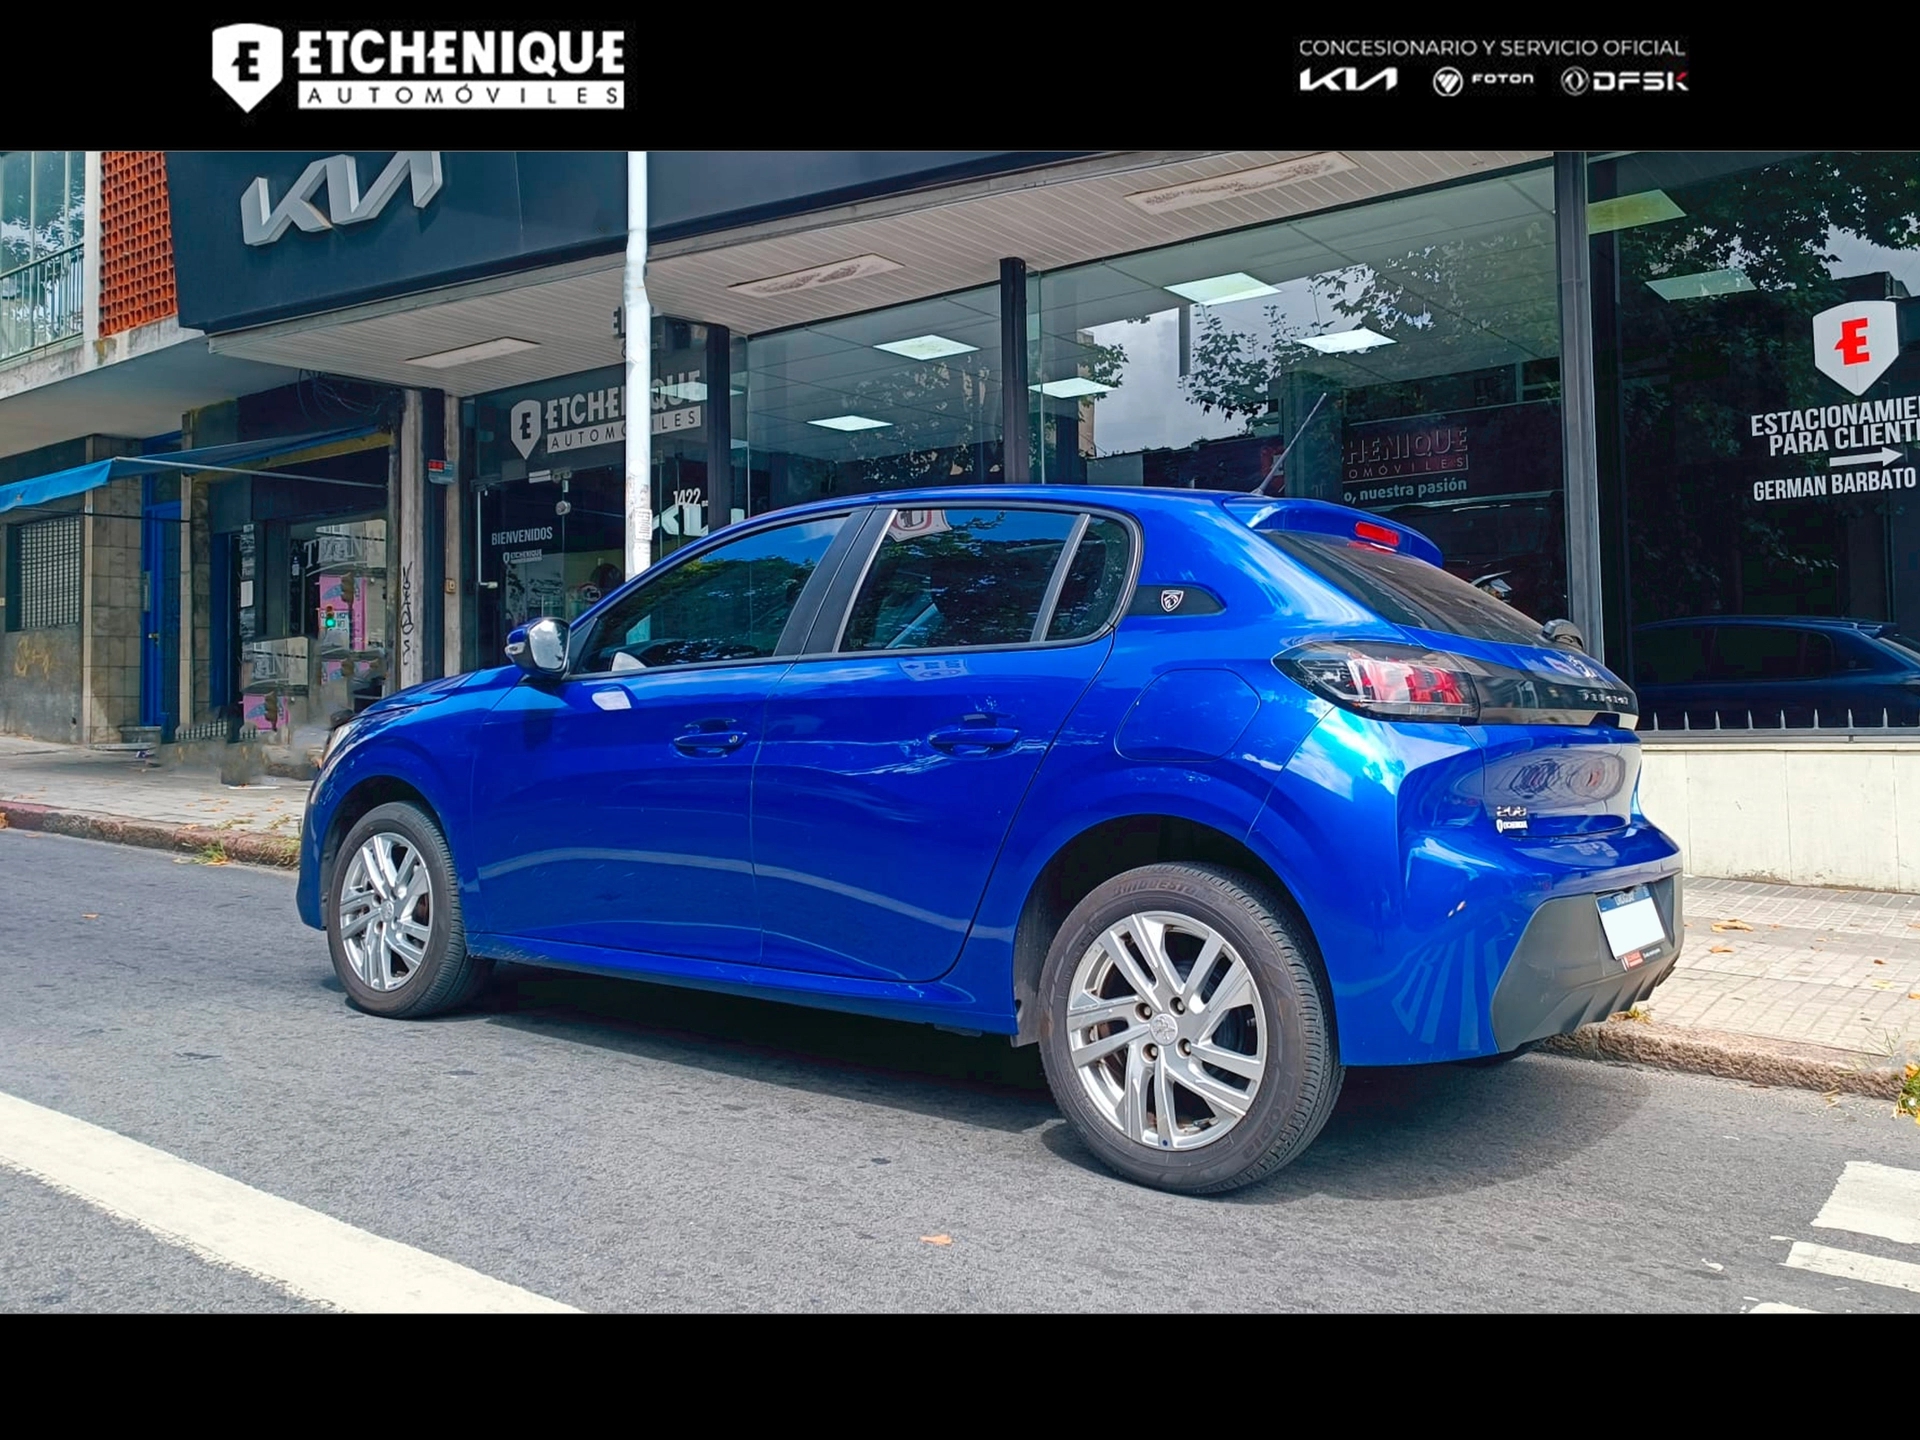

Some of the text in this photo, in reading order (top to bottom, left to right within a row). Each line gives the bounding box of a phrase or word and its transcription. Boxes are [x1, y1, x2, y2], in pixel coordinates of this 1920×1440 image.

[1341, 426, 1468, 466] HENIQUE
[1769, 430, 1829, 457] PARA
[1360, 484, 1414, 501] nuestra
[1418, 477, 1467, 498] pasión
[1753, 467, 1917, 501] GERMAN BARBATO
[491, 526, 553, 546] BIENVENIDOS
